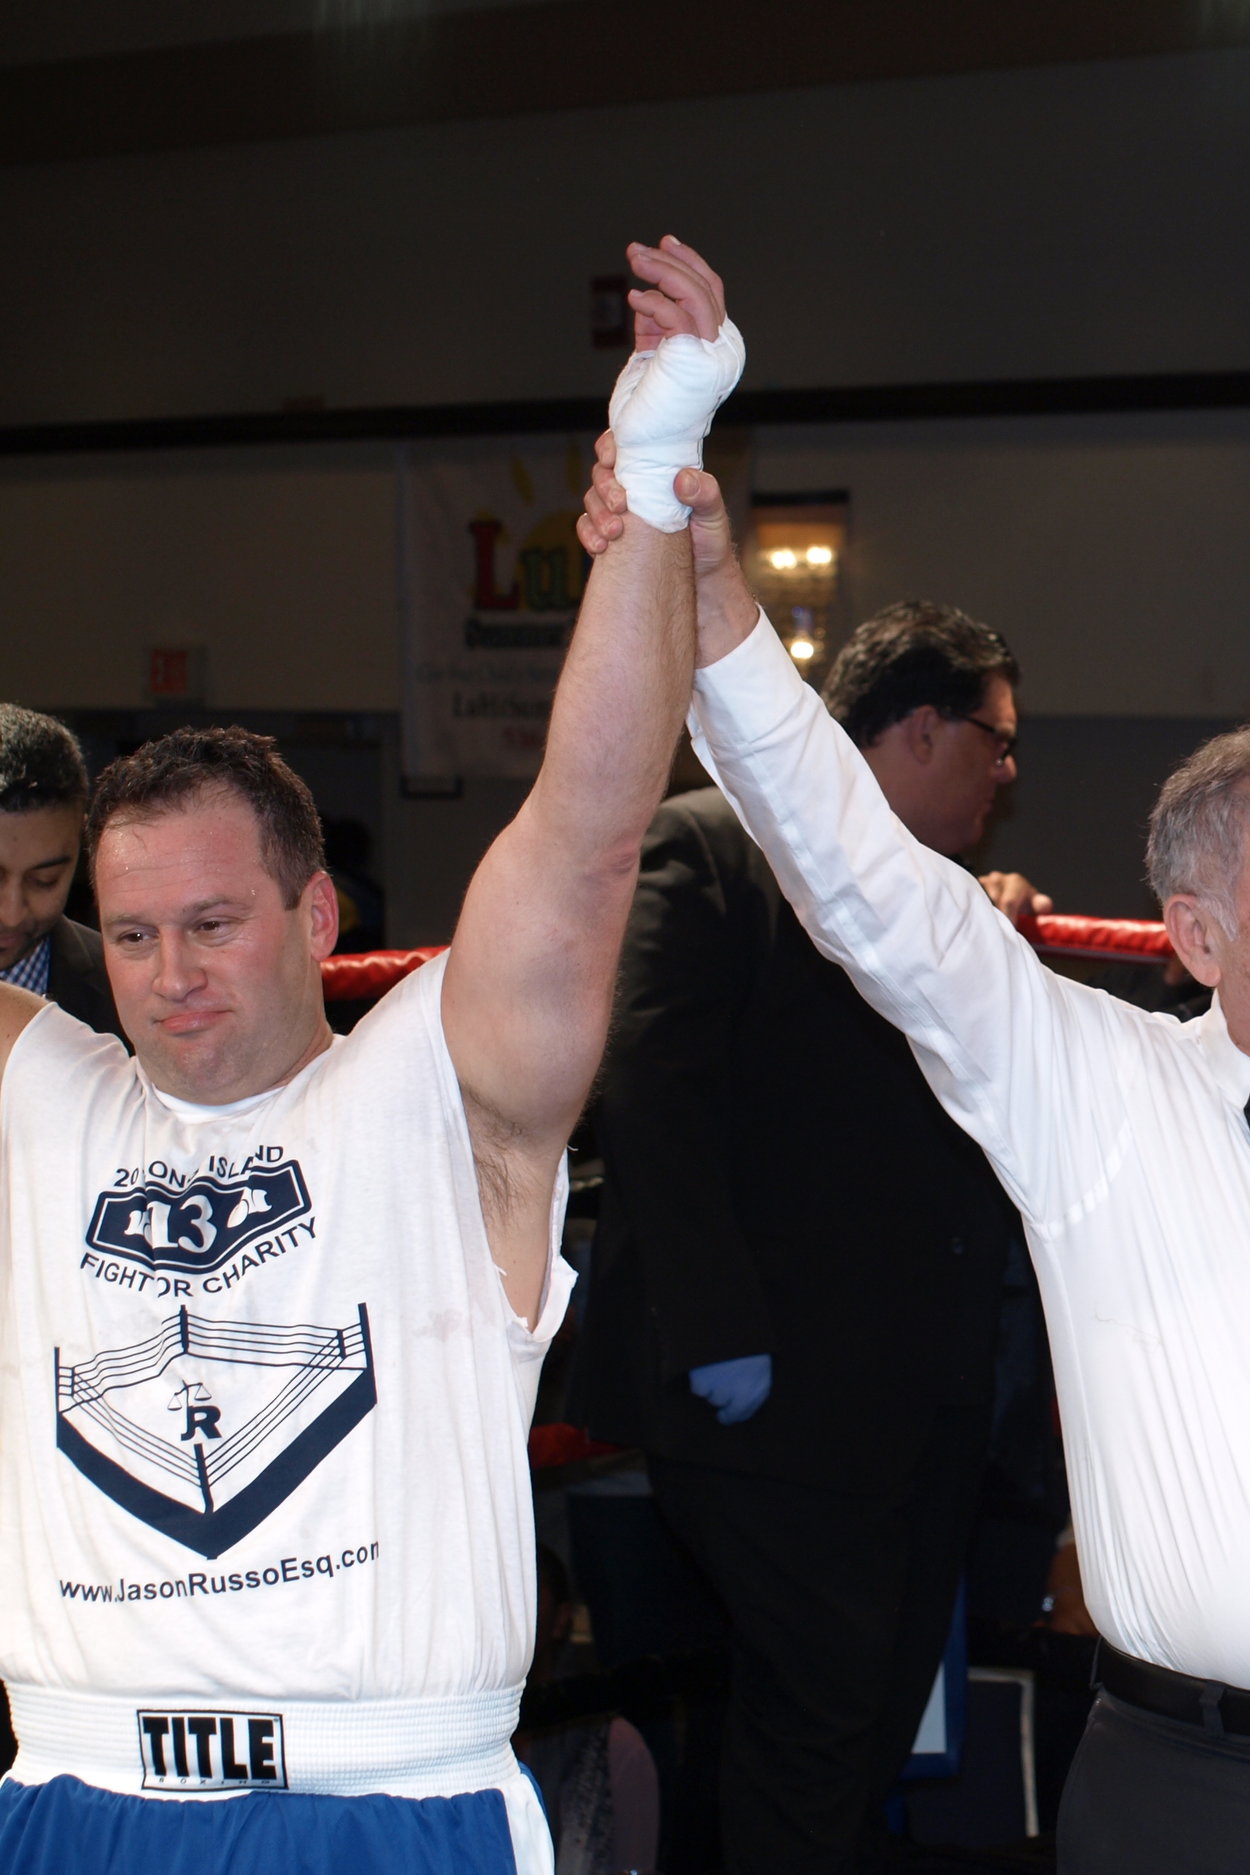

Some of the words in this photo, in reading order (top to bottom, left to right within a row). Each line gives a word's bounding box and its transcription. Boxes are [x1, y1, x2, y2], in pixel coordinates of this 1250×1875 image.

[468, 518, 592, 612] Lu
[148, 1160, 199, 1188] ON
[146, 1194, 217, 1254] 13
[80, 1252, 155, 1292] FIGHT
[156, 1276, 194, 1298] OR
[202, 1217, 317, 1293] CHARITY
[142, 1716, 277, 1780] TITLE
